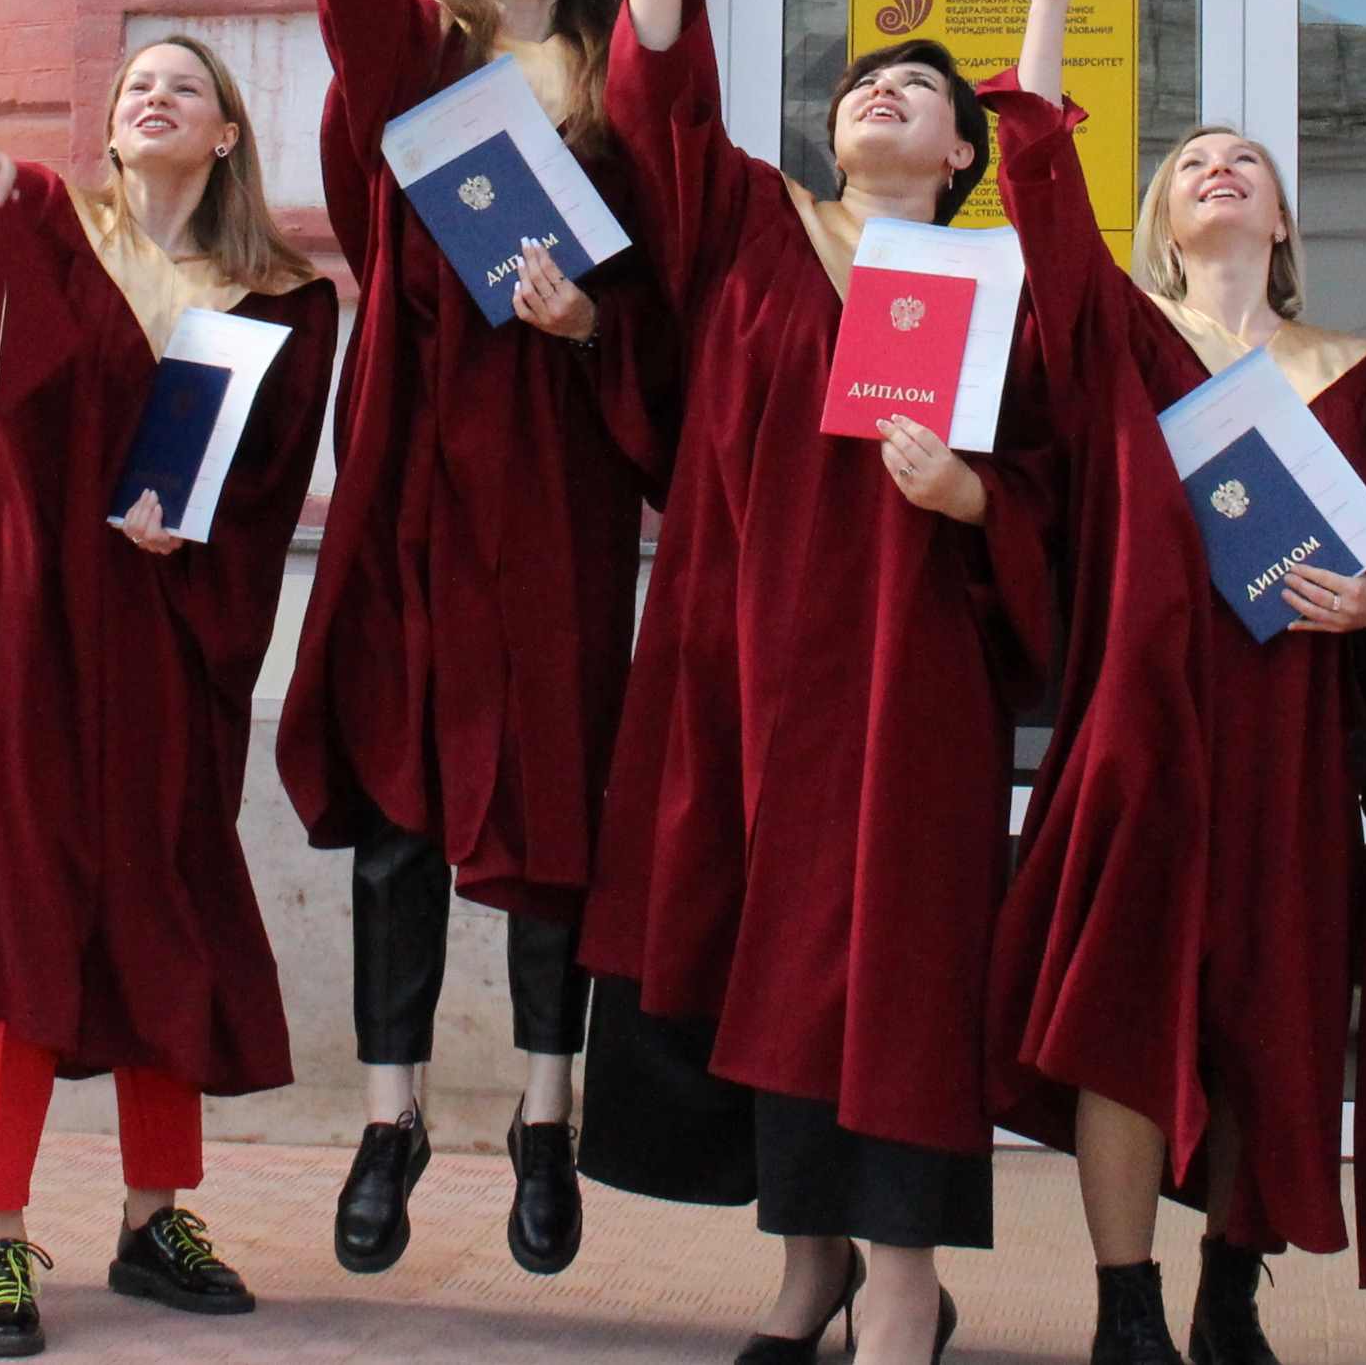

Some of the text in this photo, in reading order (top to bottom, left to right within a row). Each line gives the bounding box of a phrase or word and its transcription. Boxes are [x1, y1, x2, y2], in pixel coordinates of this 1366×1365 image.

[485, 232, 560, 288] ДИПМ
[847, 381, 936, 404] ДИПЛОМ
[1246, 535, 1322, 603] ДИПЛОМ
